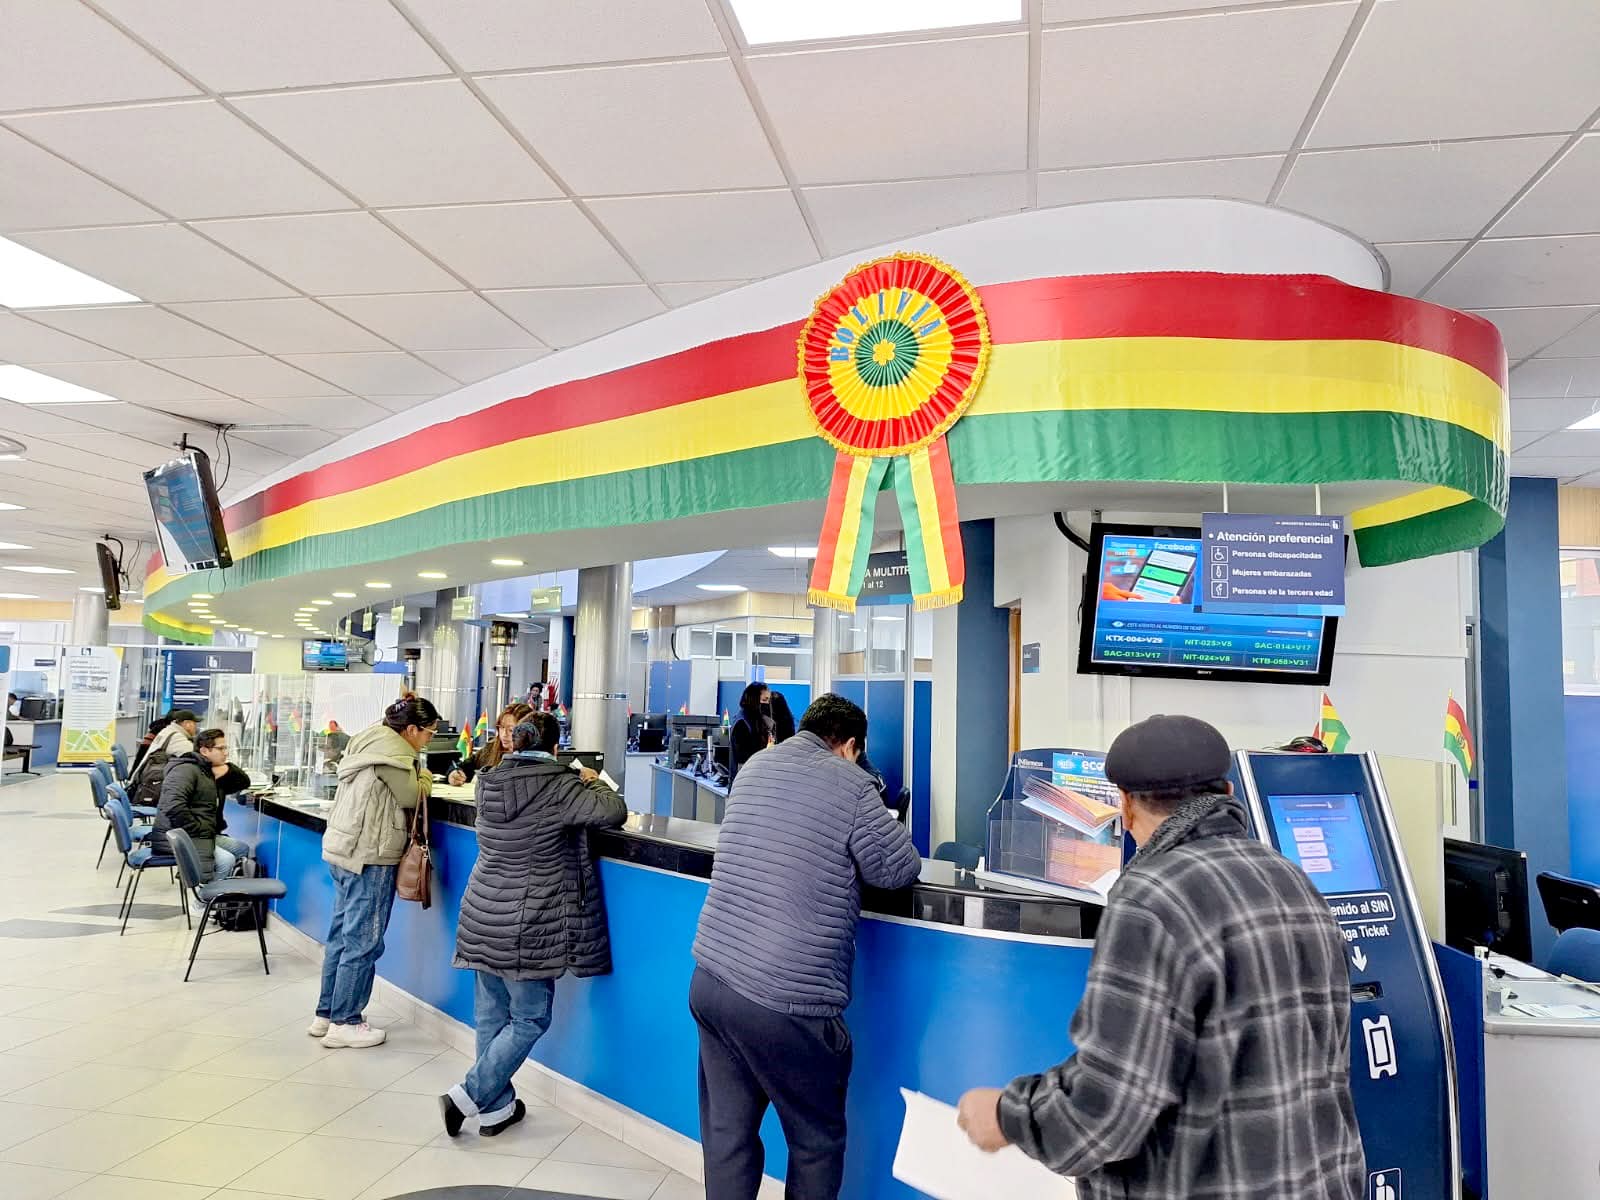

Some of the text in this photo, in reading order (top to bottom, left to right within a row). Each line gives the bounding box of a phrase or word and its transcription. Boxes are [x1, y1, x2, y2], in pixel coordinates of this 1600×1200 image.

[830, 291, 941, 361] BOLIVIA
[1216, 531, 1334, 544] Atención preferencial
[1232, 550, 1322, 560] Personas discapacitadas
[1232, 568, 1312, 578] Mujeres embarazadas
[1232, 587, 1333, 598] Personas de la tercera edad
[1360, 901, 1370, 914] al
[1370, 899, 1390, 913] SIN
[1357, 924, 1390, 938] Ticket
